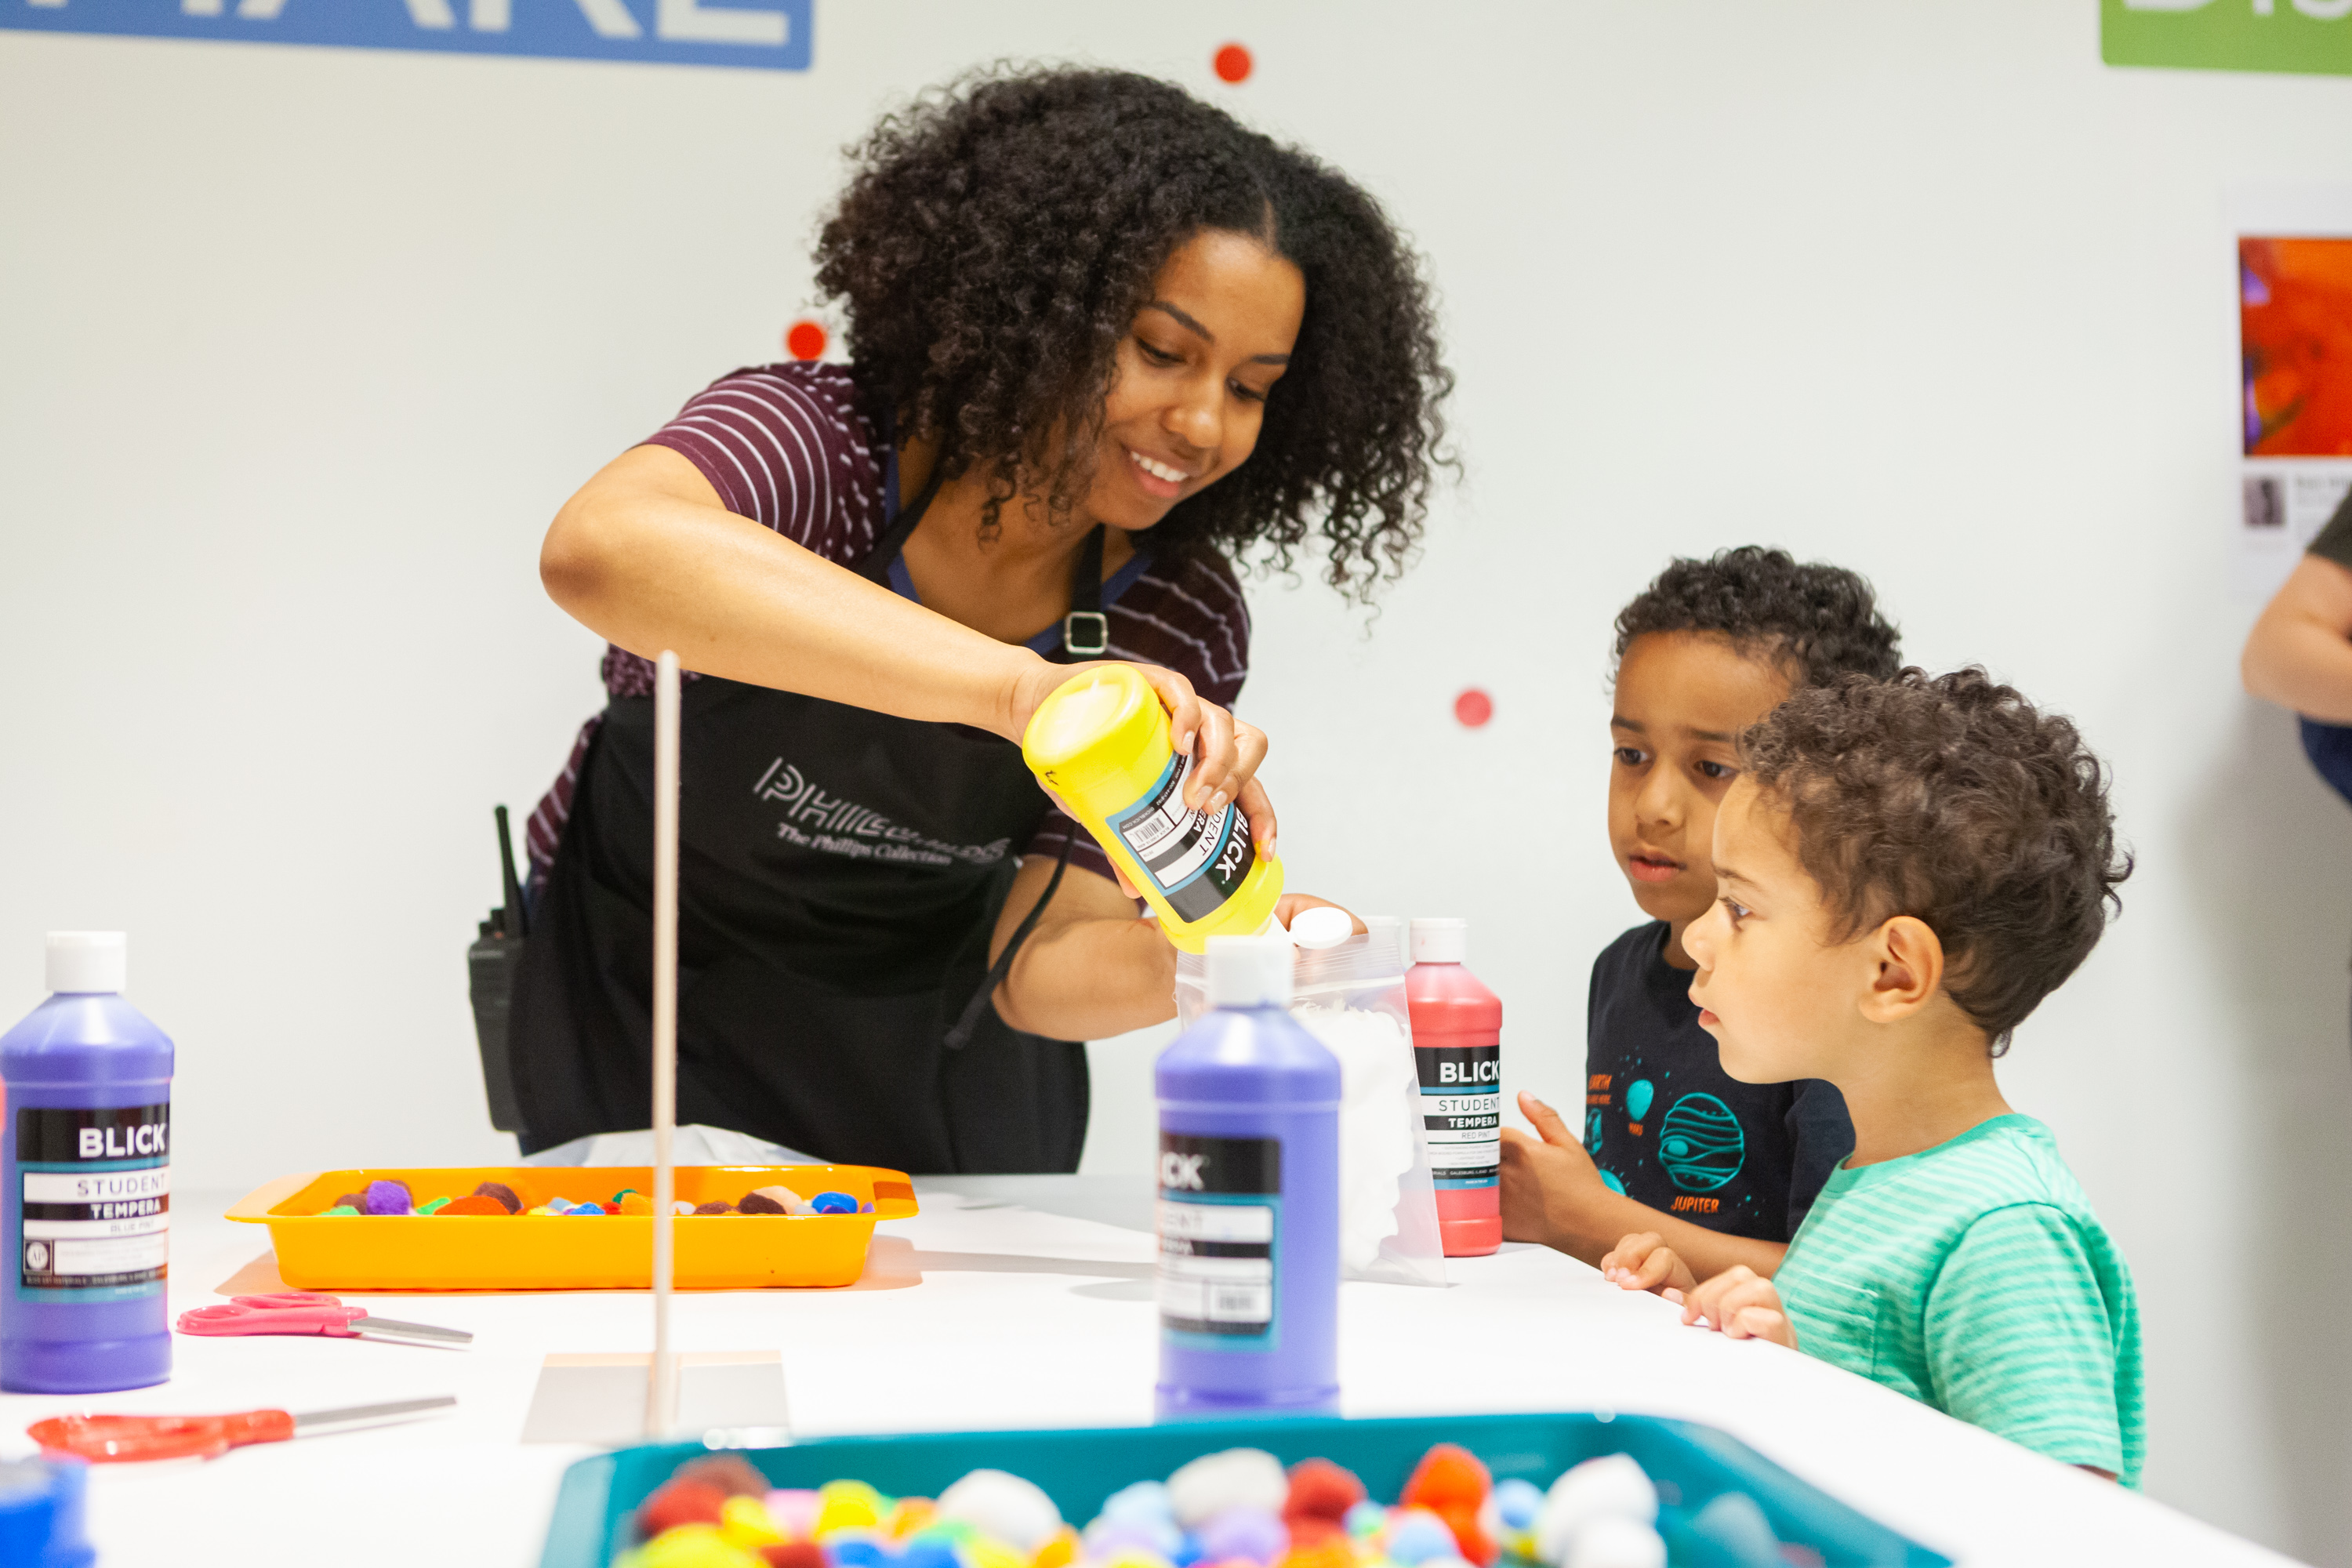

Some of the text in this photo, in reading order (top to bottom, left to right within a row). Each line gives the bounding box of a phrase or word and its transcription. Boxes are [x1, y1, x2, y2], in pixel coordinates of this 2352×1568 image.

[1200, 808, 1225, 856] DENT
[1215, 807, 1249, 881] BLICK
[1440, 1060, 1499, 1083] BLICK
[1439, 1096, 1499, 1112] STUDENT
[1448, 1116, 1497, 1128] TEMPERA
[79, 1123, 166, 1158] BLICK
[78, 1173, 165, 1197] STUDENT
[90, 1198, 162, 1220] TEMPERA
[1671, 1196, 1720, 1214] JUPITER
